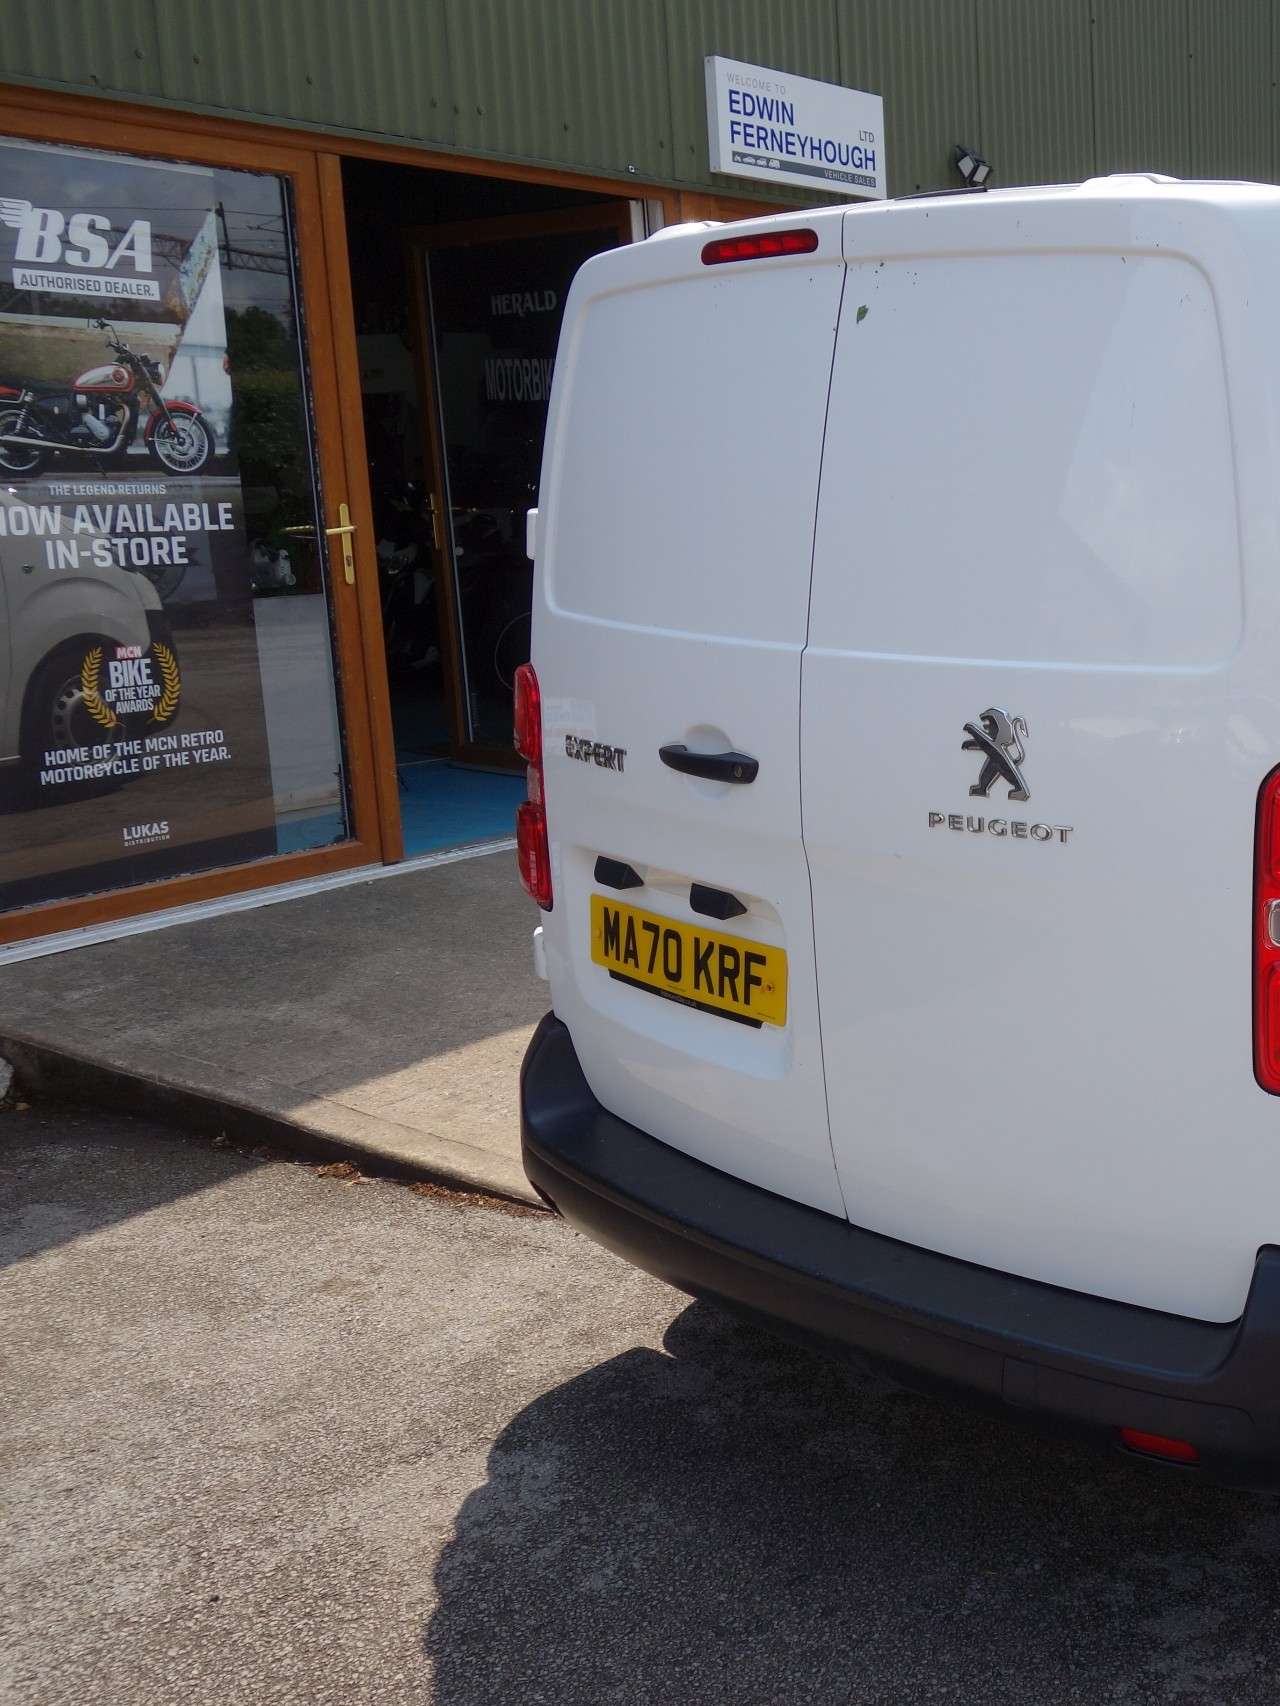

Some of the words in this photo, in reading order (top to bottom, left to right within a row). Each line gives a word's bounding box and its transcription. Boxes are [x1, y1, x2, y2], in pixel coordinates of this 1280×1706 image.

[727, 72, 772, 93] WELCOME
[775, 84, 786, 95] TO
[729, 89, 794, 126] EDWIN
[730, 120, 876, 171] FERNEYHOUGH
[859, 130, 875, 143] LTD
[824, 169, 852, 183] VEHICLE
[854, 175, 876, 187] SALES
[14, 208, 152, 272] BSA
[20, 272, 101, 293] AUTHORISED
[491, 290, 557, 317] HERALD
[49, 485, 71, 496] THE
[72, 484, 116, 496] LEGEND
[118, 484, 166, 496] RETURNS
[73, 502, 235, 535] AVAILABLE
[45, 536, 189, 569] IN-STORE
[116, 646, 142, 659] MCN
[109, 658, 153, 688] BIKE
[105, 689, 118, 702] OF
[118, 687, 137, 700] THE
[137, 685, 161, 699] YEAR
[115, 698, 154, 714] AWARDS
[45, 748, 89, 766] HOME
[94, 744, 111, 760] OF
[114, 741, 142, 757] THE
[145, 736, 178, 752] MCN
[181, 730, 224, 748] RETRO
[565, 734, 627, 773] EXPERT
[40, 758, 140, 785] MOTORCYCLE
[142, 755, 160, 771] OF
[164, 751, 190, 767] THE
[192, 747, 232, 763] YEAR.
[122, 821, 169, 841] LUKAS
[124, 834, 170, 847] DISTRIBUTION
[928, 811, 1074, 843] PEUGEOT
[602, 906, 683, 983] MA70
[693, 940, 767, 1005] KRF
